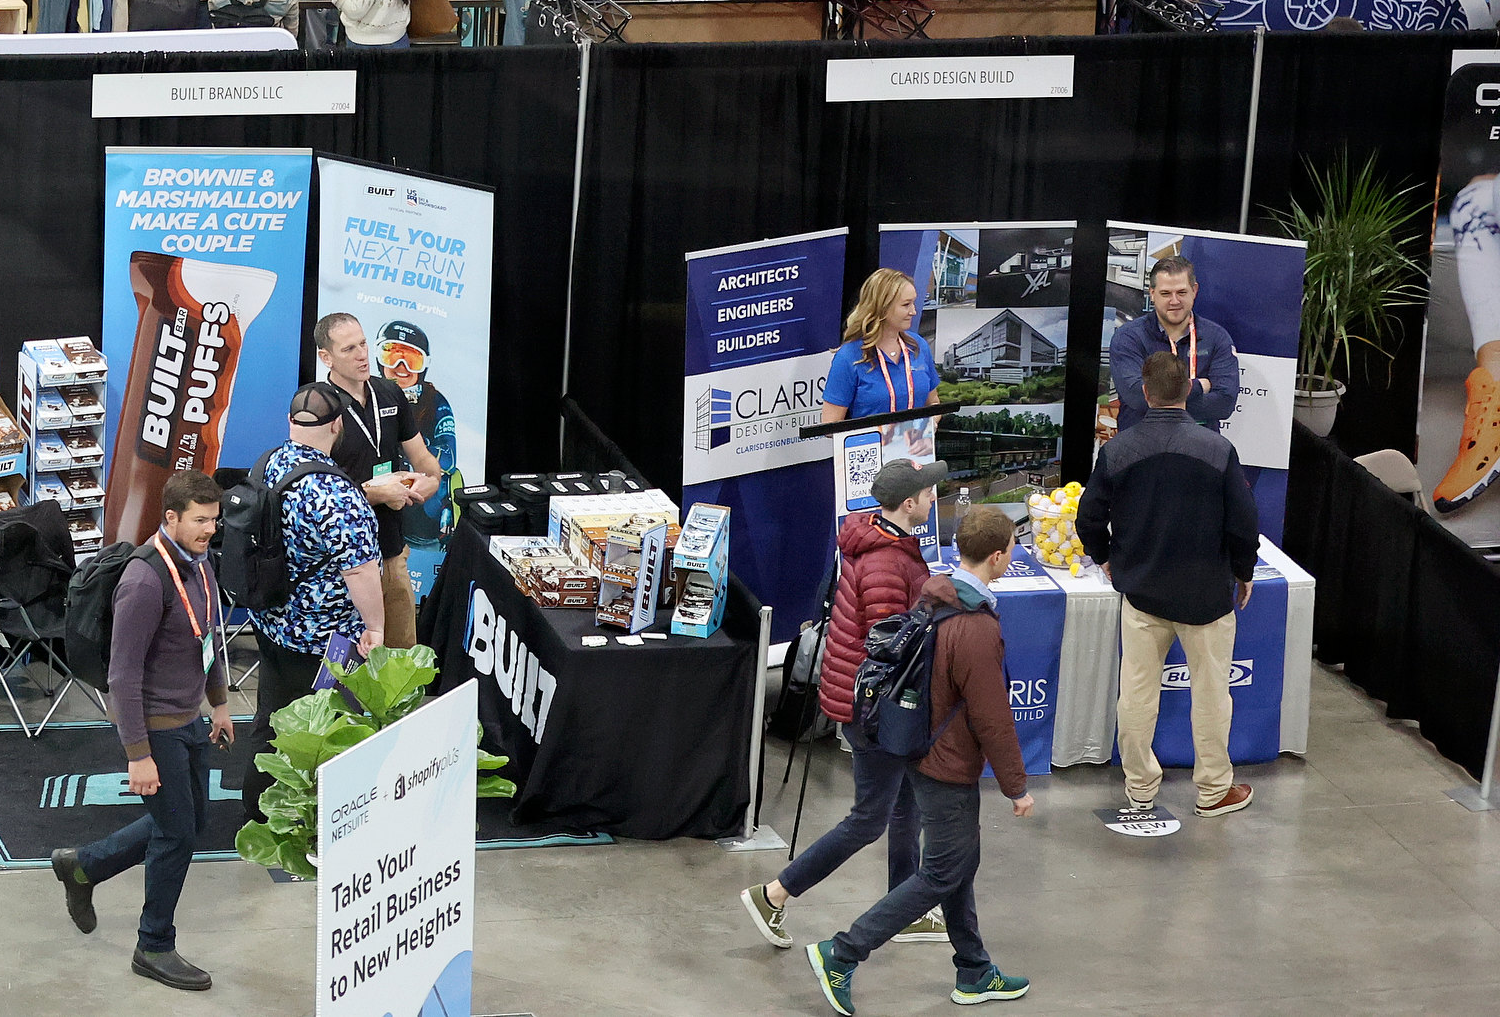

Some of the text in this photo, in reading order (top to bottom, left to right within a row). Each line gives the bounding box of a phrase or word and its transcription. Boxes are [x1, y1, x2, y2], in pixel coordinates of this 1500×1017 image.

[891, 70, 1014, 85] CLARIS DESIGN BUILD
[171, 86, 283, 100] BUILT BRANDS LLC
[143, 168, 275, 187] BROWNIE &
[115, 191, 302, 209] MARSHMALLOW
[367, 186, 395, 197] BUILT
[407, 188, 417, 196] US
[419, 202, 447, 211] SNOWBOARD
[130, 213, 287, 231] MAKE A CUTE
[161, 235, 255, 252] COUPLE
[345, 216, 465, 257] FUEL YOUR
[344, 237, 465, 280] NEXT RUN
[344, 259, 464, 299] WITH BUILT!
[718, 265, 799, 291] ARCHITECTS
[357, 292, 447, 318] #youGOTTAtrythis
[718, 297, 794, 322] ENGINEERS
[173, 307, 188, 336] BAR
[717, 330, 780, 353] BUILDERS
[182, 302, 231, 424] PUFFS
[142, 323, 188, 449] BUILT
[736, 376, 827, 419] CLARIS
[381, 407, 396, 416] BUILT
[642, 537, 658, 609] BUILT
[686, 561, 707, 569] BUILT
[566, 597, 586, 605] BUILT
[469, 588, 557, 745] BUILT
[331, 785, 378, 824] ORACLE
[331, 810, 370, 843] NETSUITE
[1122, 822, 1167, 830] NEW
[331, 843, 417, 913] Take Your
[331, 858, 461, 960] Retail Business
[330, 900, 461, 1003] to New Heights
